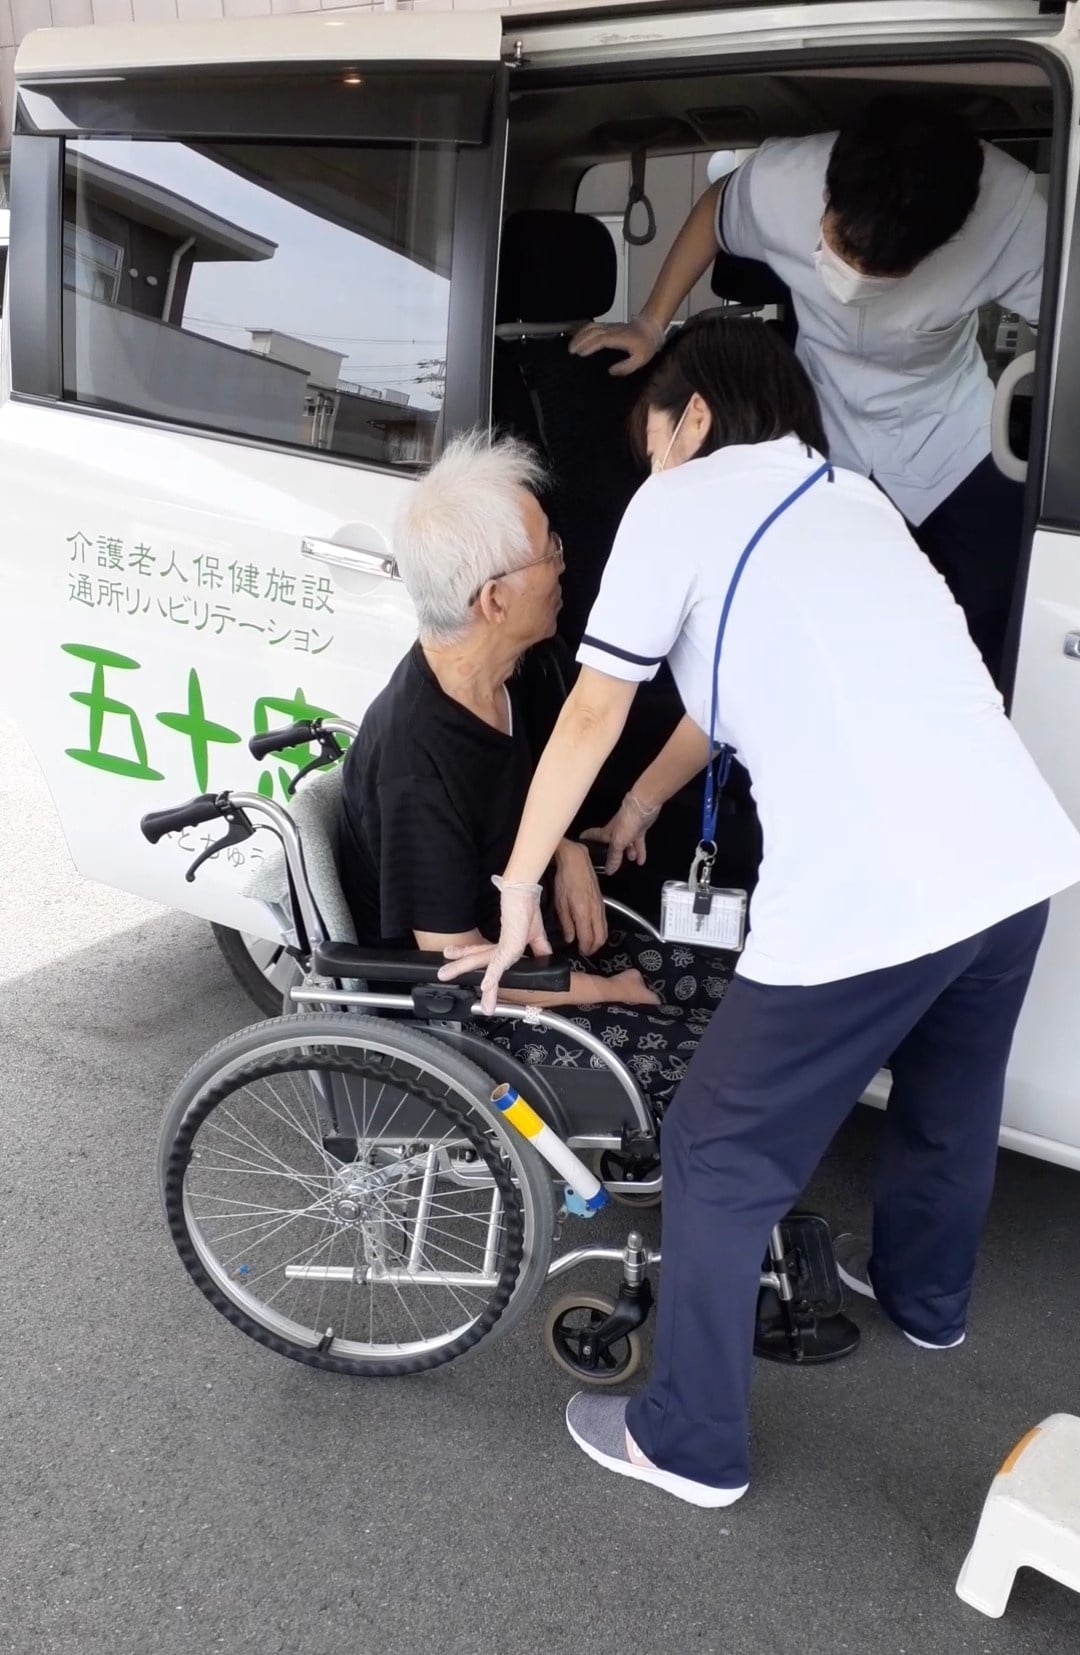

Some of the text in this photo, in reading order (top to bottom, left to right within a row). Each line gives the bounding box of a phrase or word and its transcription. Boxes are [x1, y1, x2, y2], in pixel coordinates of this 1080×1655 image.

[65, 530, 335, 614] 介護老人保健施設
[68, 572, 335, 655] 通所リハビリテーション
